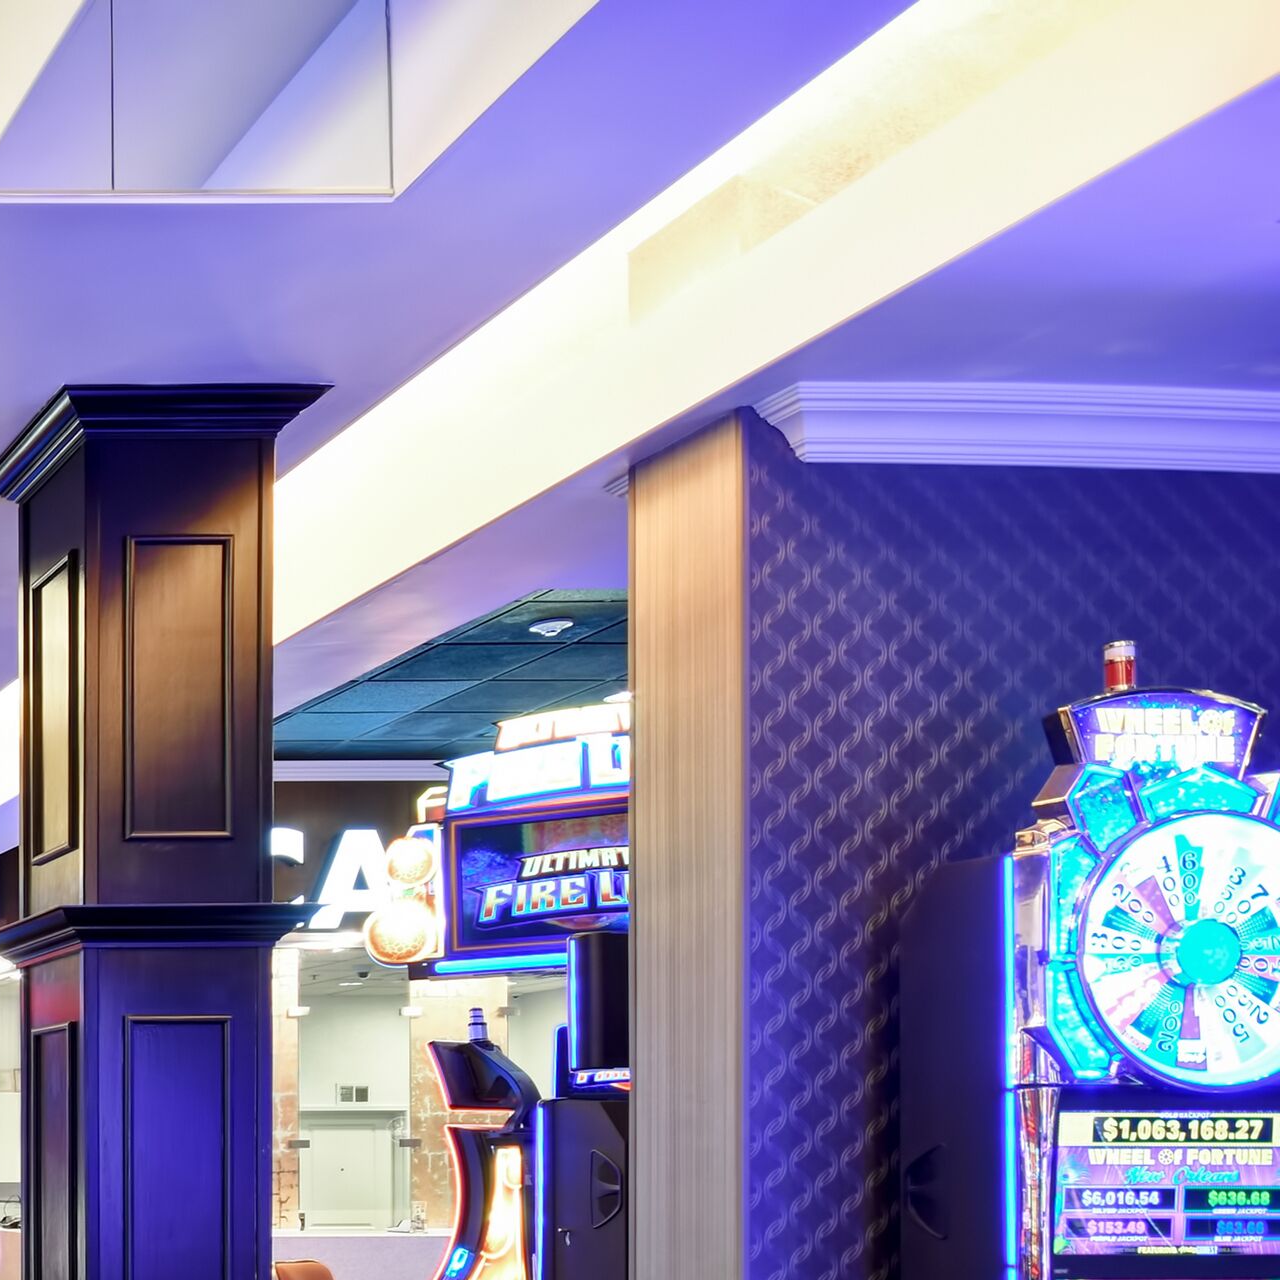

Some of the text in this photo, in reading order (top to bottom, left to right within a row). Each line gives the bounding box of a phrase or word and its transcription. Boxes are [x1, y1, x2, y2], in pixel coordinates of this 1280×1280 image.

[479, 875, 588, 923] FIRE
[1102, 1117, 1264, 1142] $1,063,168.27
[1088, 1149, 1155, 1166] WHEEL
[1186, 1149, 1273, 1166] FORTUNE
[1124, 1165, 1240, 1185] New Orleans
[1081, 1189, 1160, 1207] $6,016.54
